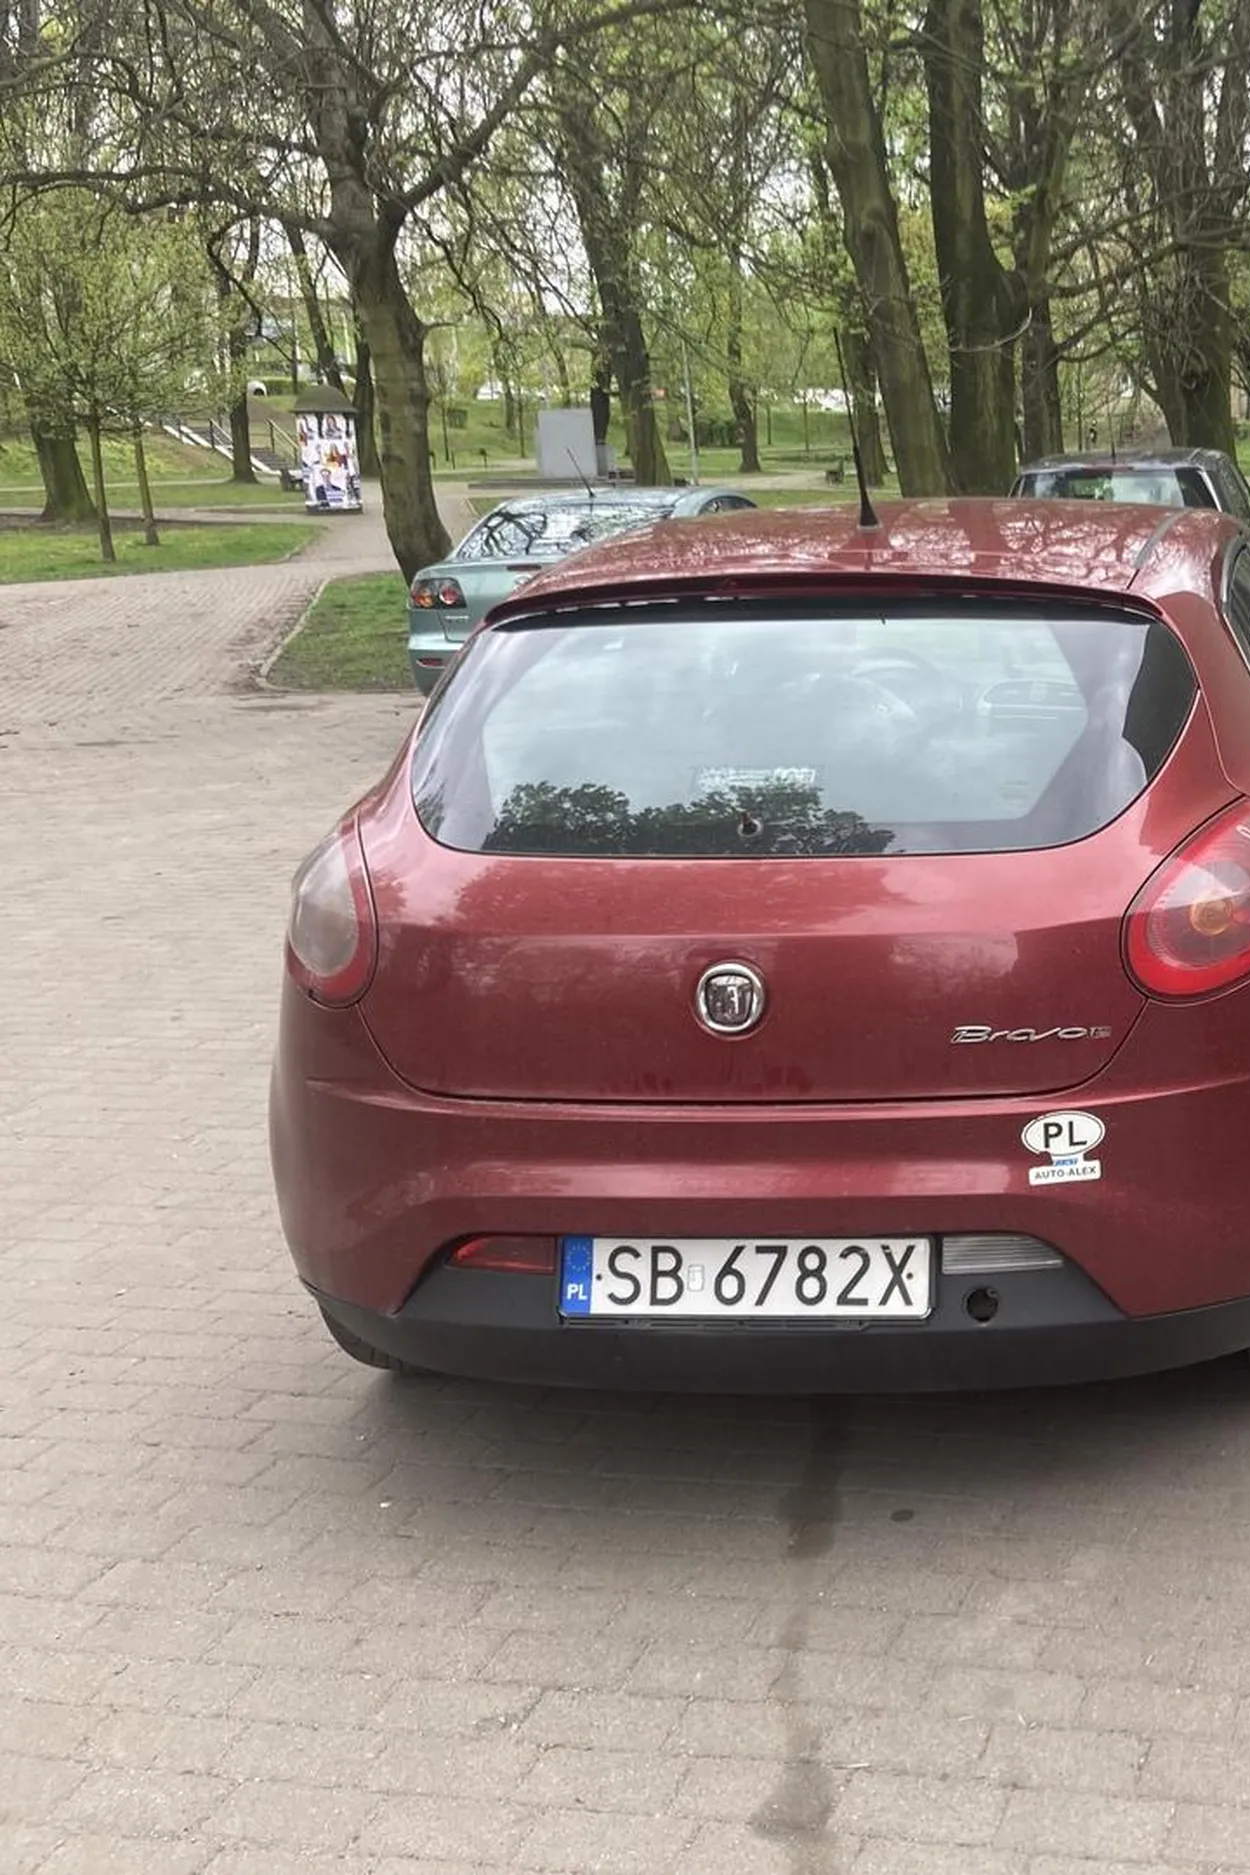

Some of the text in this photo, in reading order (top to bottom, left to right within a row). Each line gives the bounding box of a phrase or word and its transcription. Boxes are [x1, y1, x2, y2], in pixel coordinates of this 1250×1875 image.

[950, 1025, 1088, 1045] Bravo
[1042, 1120, 1088, 1149] PL
[1033, 1165, 1097, 1181] AUTO ALEX
[566, 1243, 917, 1307] PL SB 6782X
